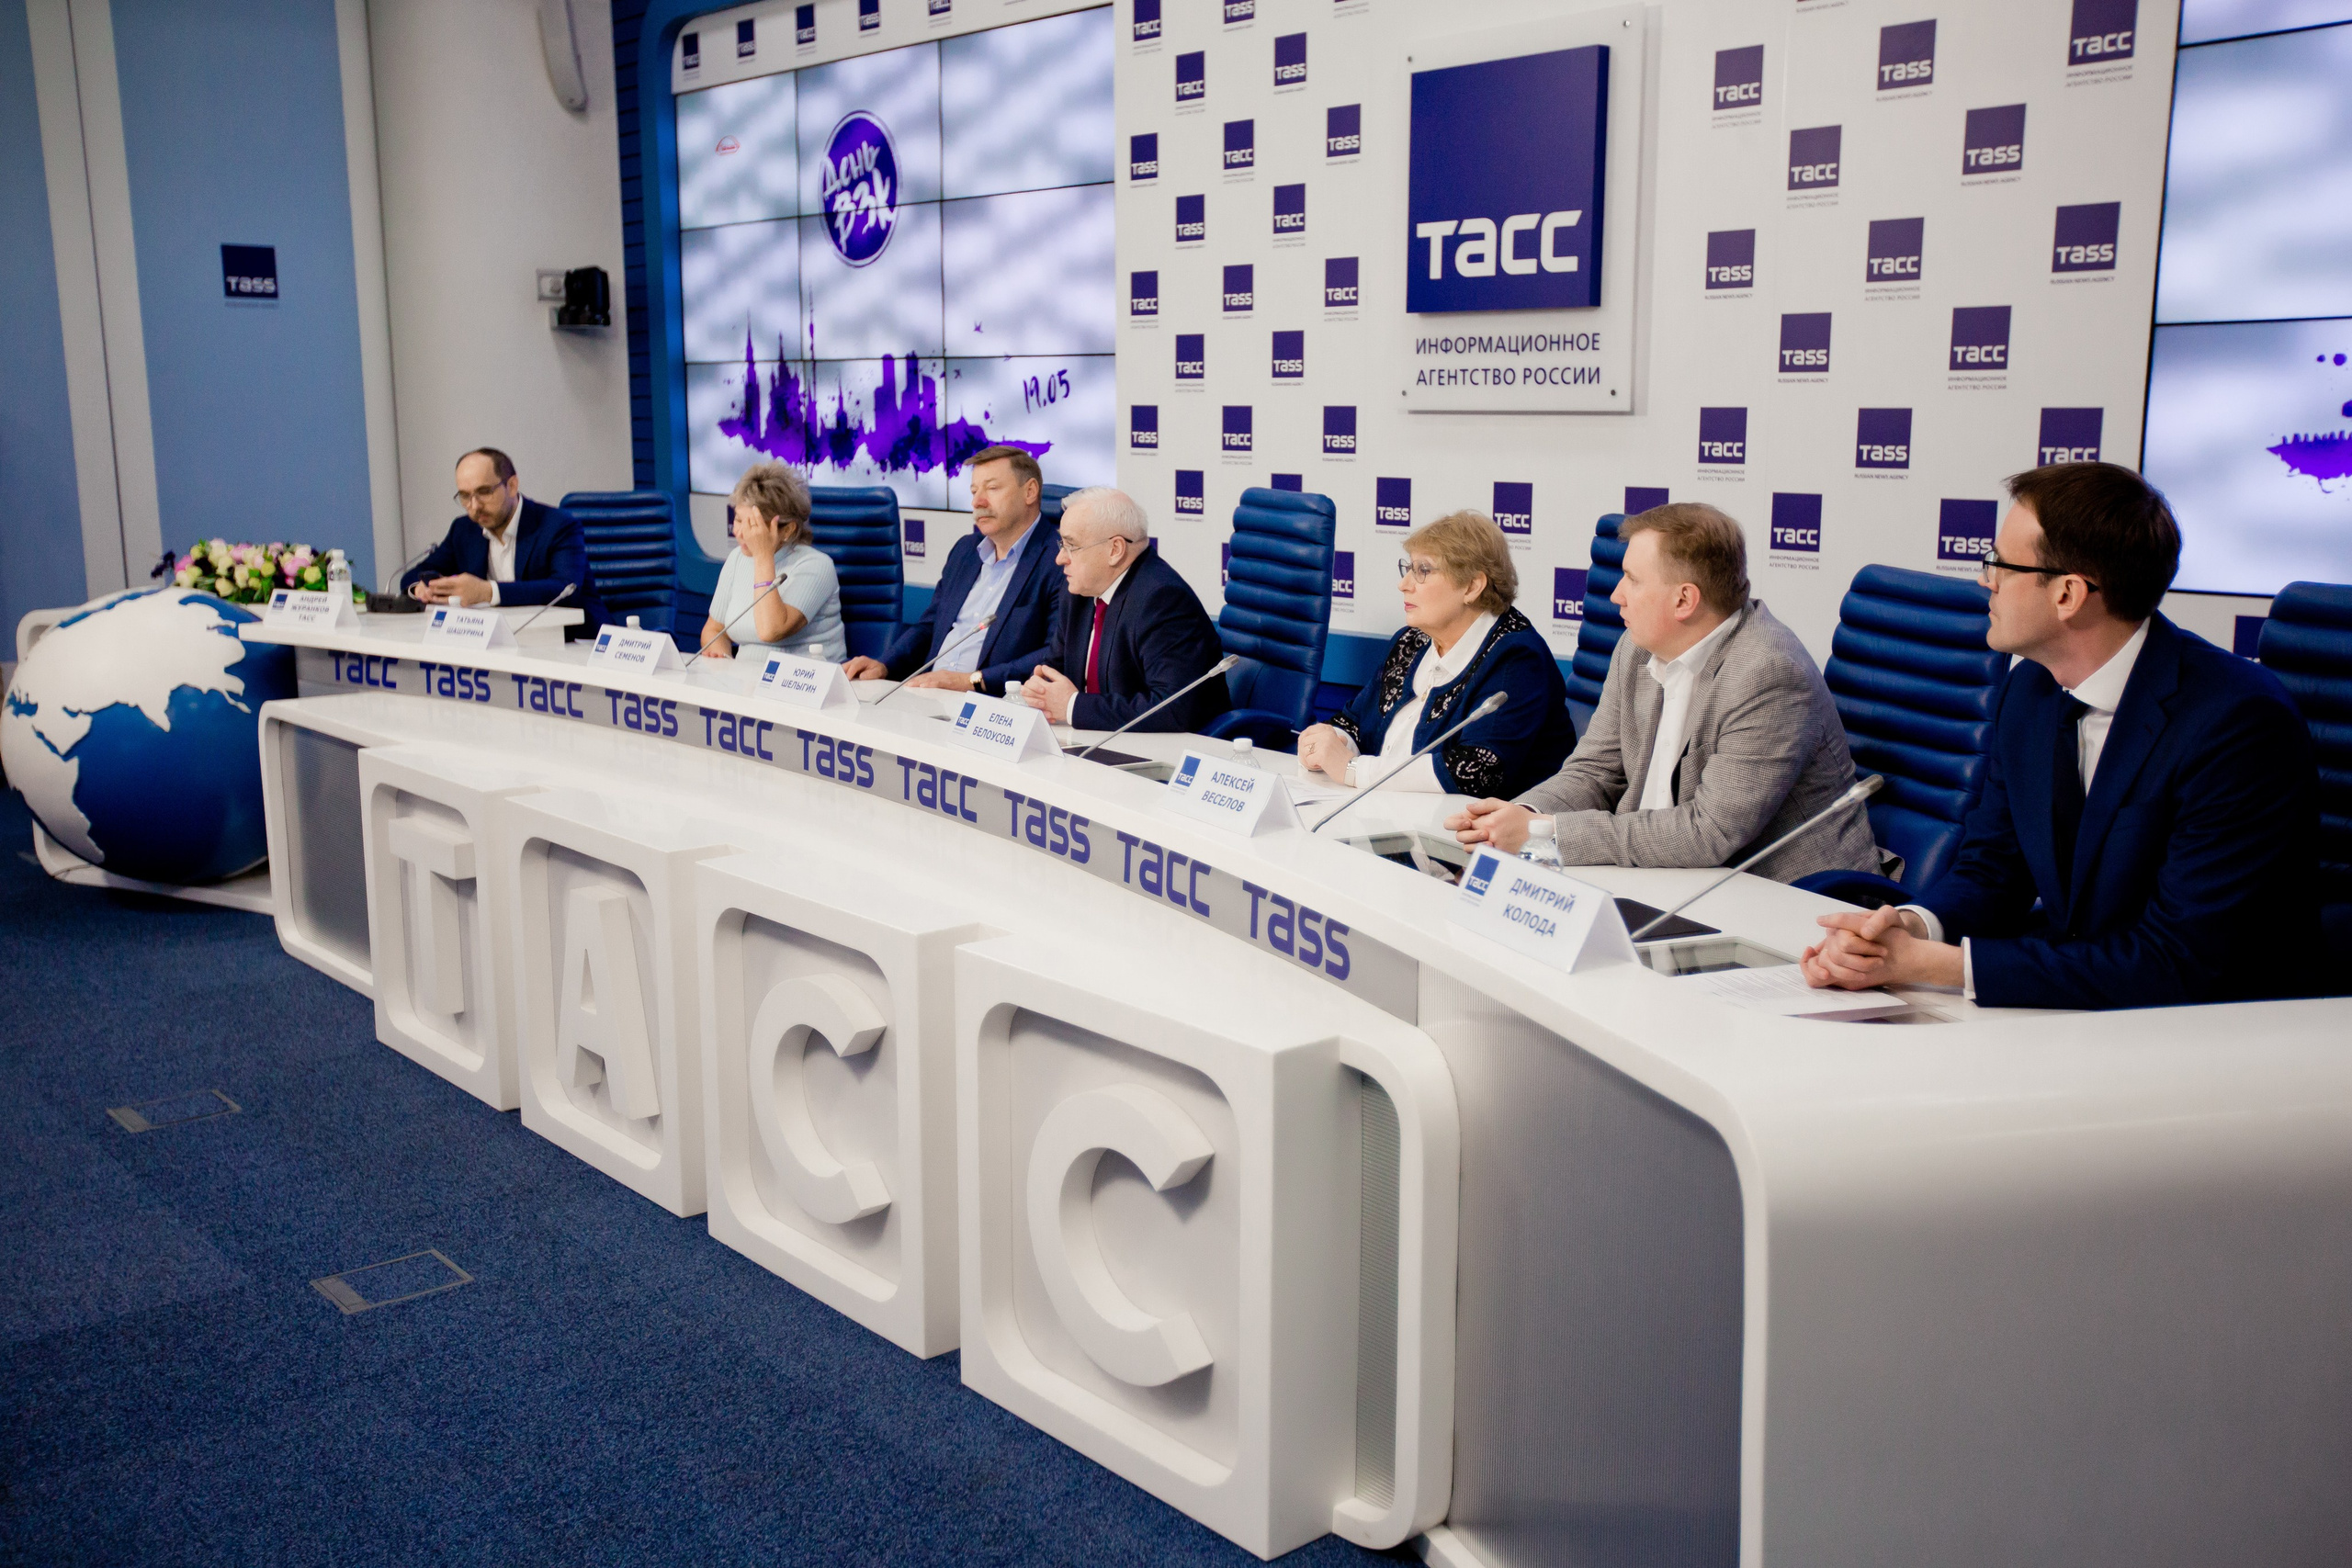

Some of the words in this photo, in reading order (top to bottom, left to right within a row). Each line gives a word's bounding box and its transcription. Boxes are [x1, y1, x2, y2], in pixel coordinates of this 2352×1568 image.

[1416, 333, 1600, 355] ИНФОРМАЦИОННОЕ
[1416, 368, 1516, 386] АГЕНТСТВО
[1522, 367, 1600, 385] РОССИИ
[1023, 368, 1069, 414] 19.05
[618, 638, 652, 650] ДМИТРИЙ
[615, 650, 645, 662] СЕМЕНОВ
[793, 668, 816, 680] ЮРИЙ
[781, 679, 817, 694] ШЕЛЫГИН
[989, 713, 1013, 728] ЕЛЕНА
[972, 726, 1015, 747] БЕЛОУСОВА
[1211, 771, 1256, 794] АЛЕКСЕЙ
[1201, 790, 1246, 812] ВЕСЕЛОВ
[1510, 877, 1577, 914] ДМИТРИЙ
[1502, 903, 1557, 937] КОЛОДА
